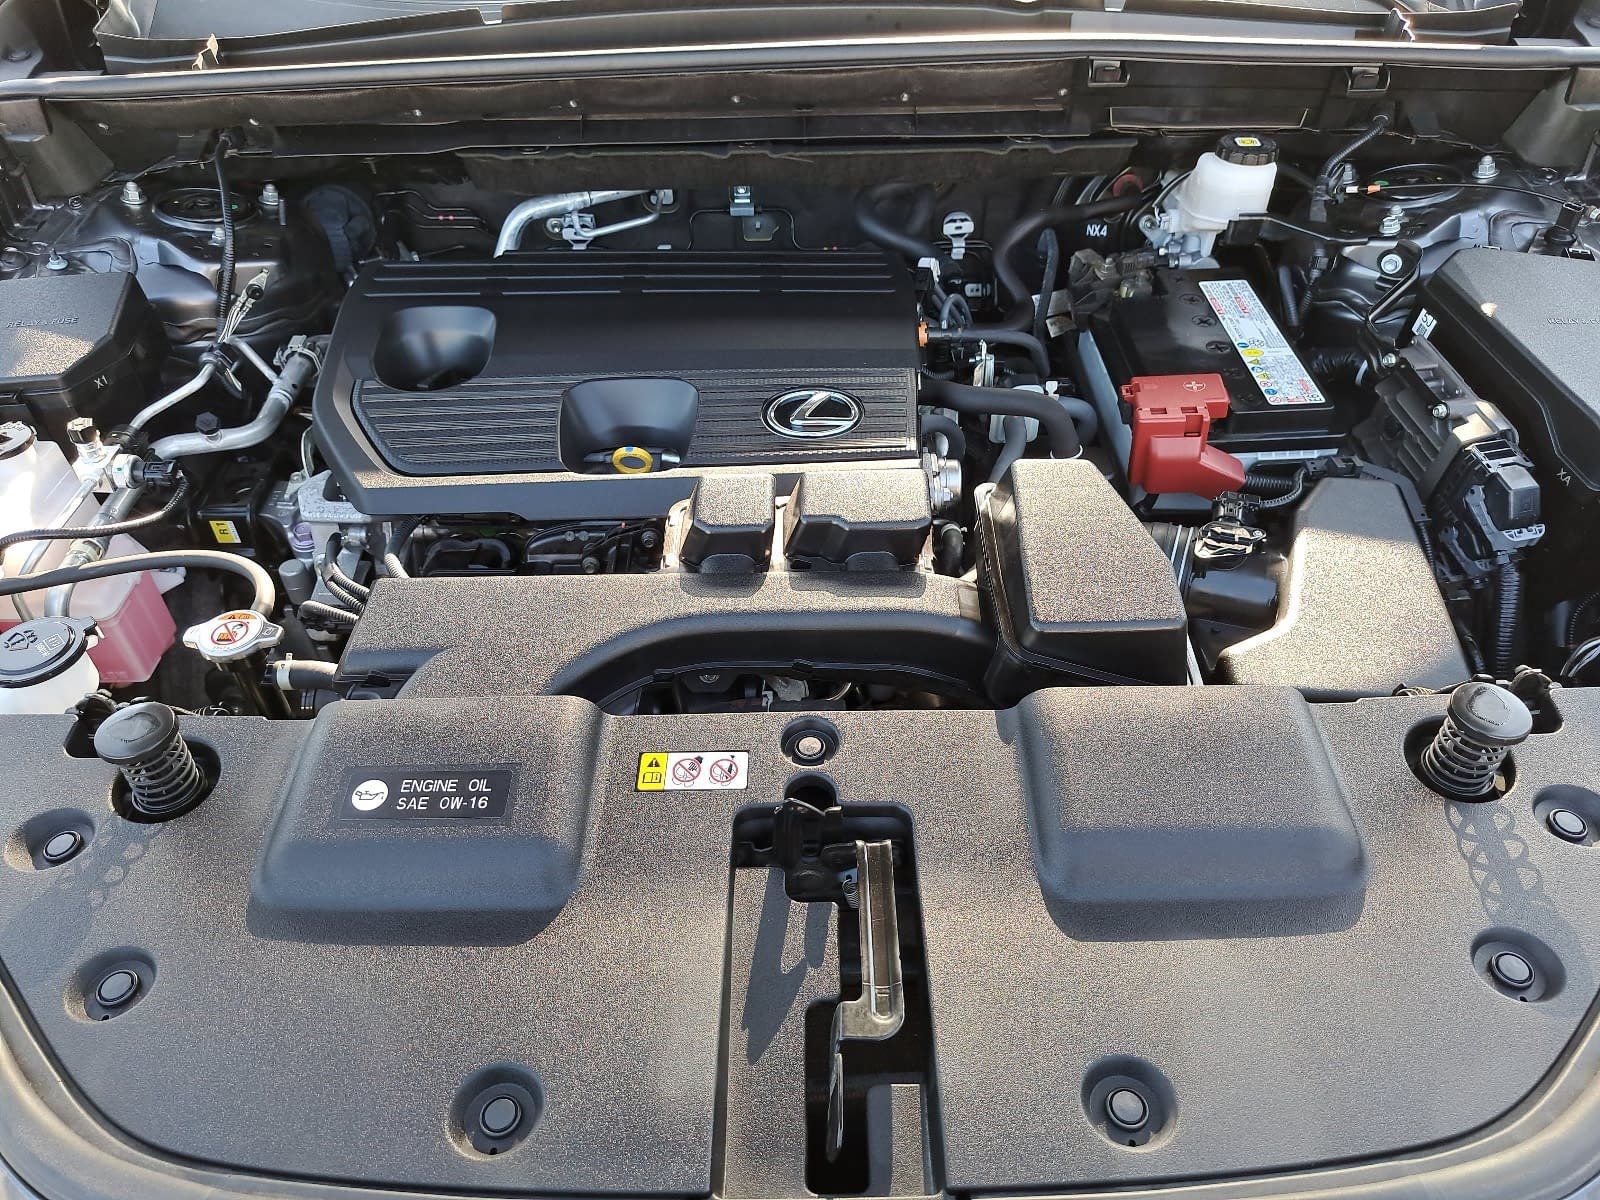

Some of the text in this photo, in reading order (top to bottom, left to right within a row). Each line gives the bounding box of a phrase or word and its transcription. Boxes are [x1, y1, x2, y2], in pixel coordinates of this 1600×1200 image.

[400, 779, 492, 793] ENGINE OIL
[396, 796, 430, 810] SAE
